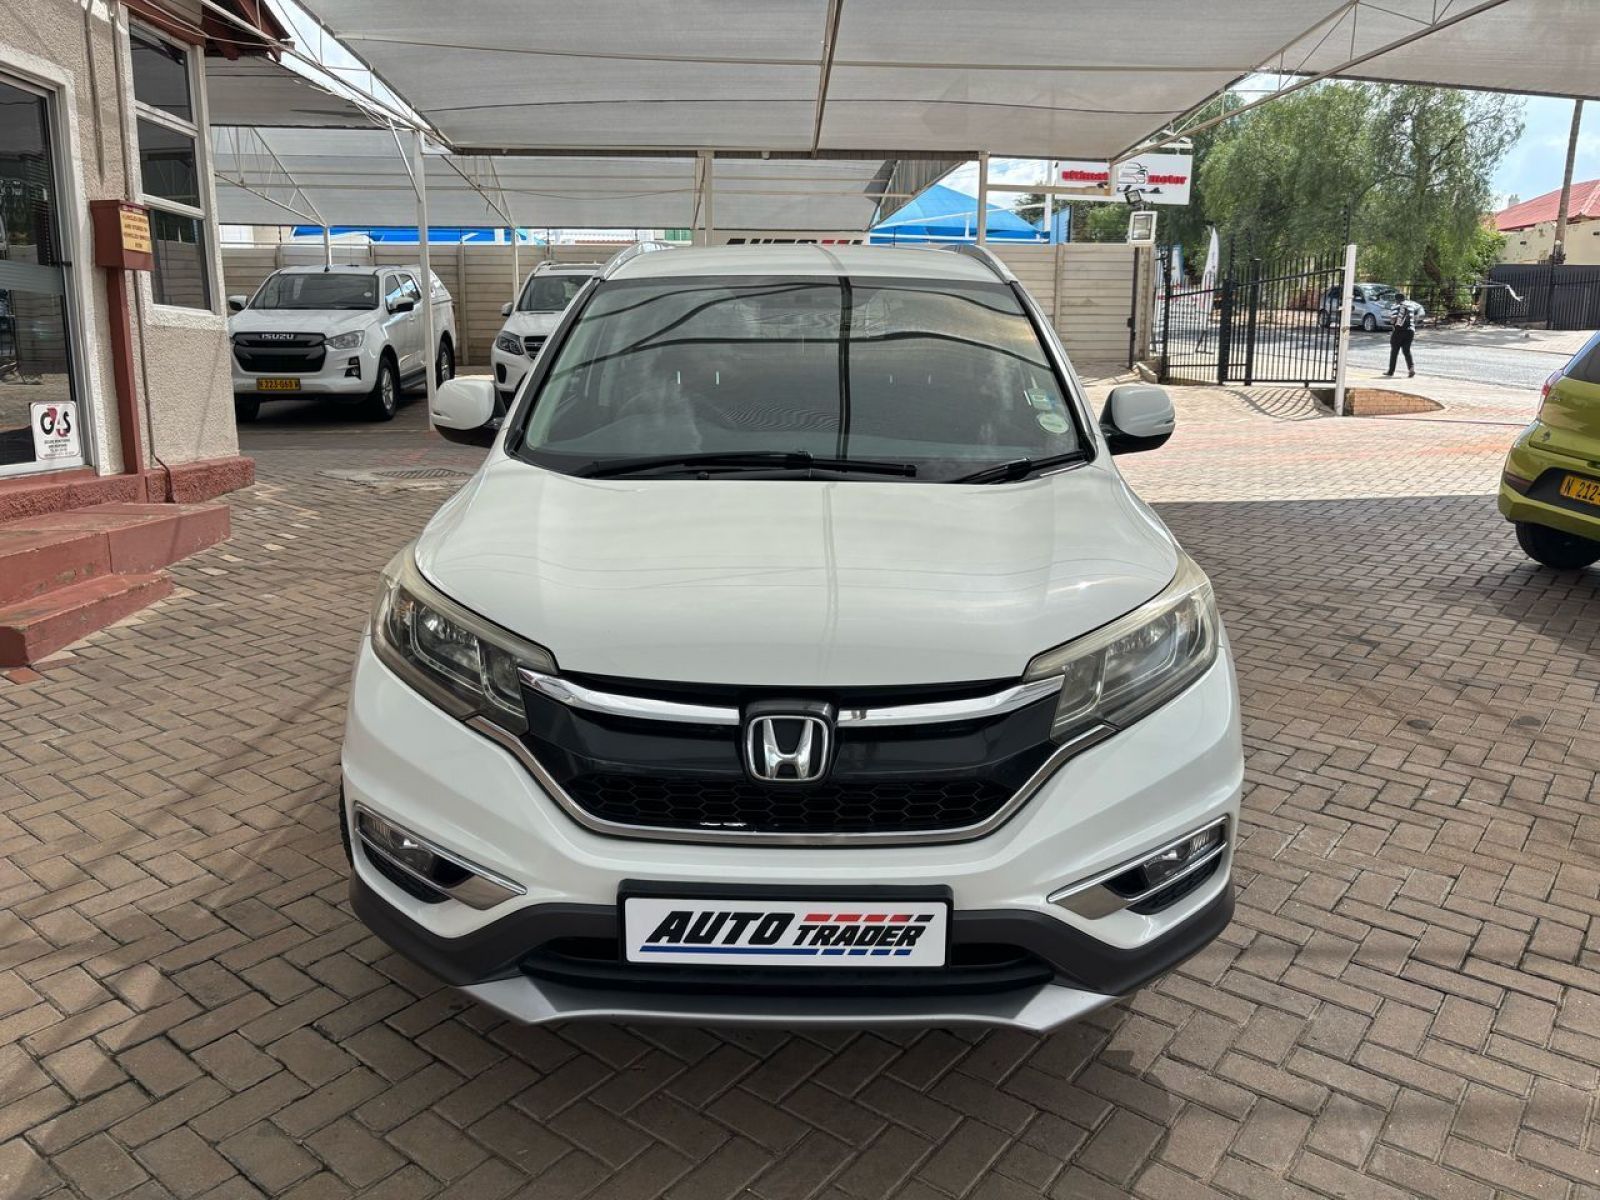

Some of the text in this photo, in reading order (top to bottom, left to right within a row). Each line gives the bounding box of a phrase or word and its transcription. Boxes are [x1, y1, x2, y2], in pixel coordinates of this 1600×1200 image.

[1576, 481, 1600, 502] 212-
[645, 911, 928, 947] AUTO TRADER
